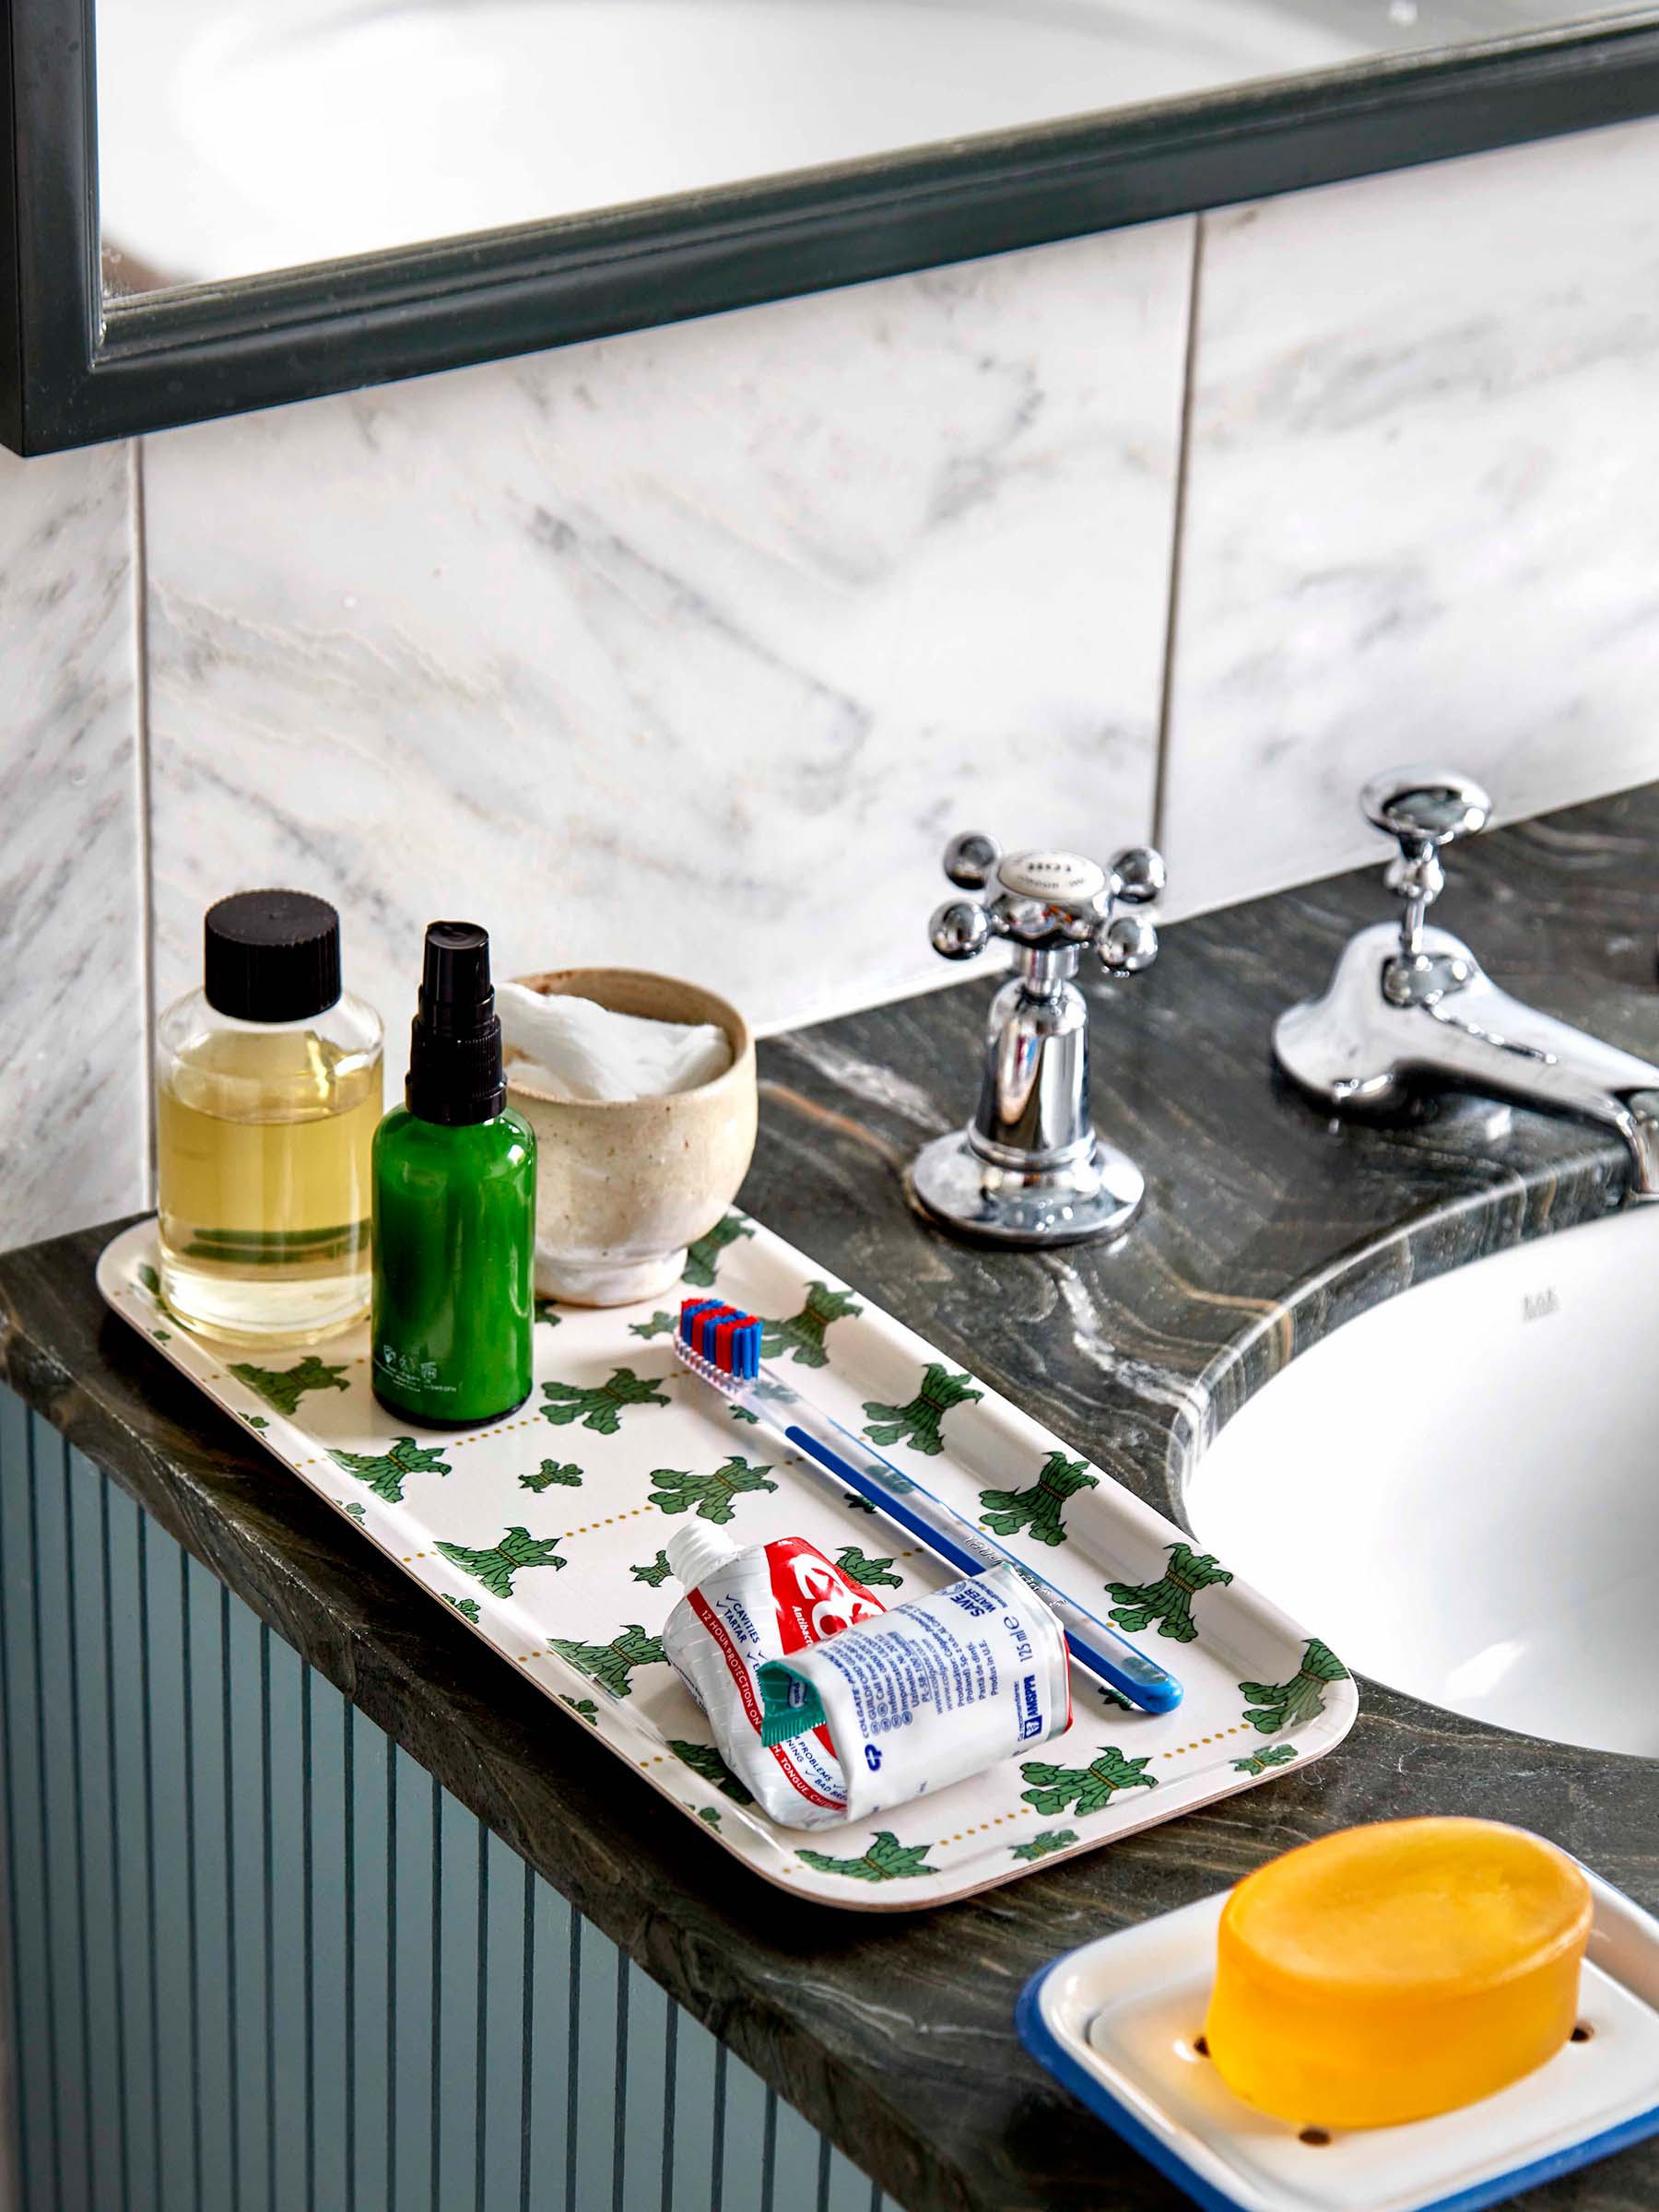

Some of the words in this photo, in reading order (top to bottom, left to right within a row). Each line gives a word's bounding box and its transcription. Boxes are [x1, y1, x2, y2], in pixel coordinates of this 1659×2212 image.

[950, 1594, 985, 1617] SAVE
[964, 1588, 996, 1612] WATER
[724, 1608, 747, 1643] TARTAR
[733, 1603, 760, 1644] CAVITIES
[792, 1606, 814, 1645] Antibact
[1009, 1630, 1028, 1642] ml
[701, 1609, 712, 1621] 12
[710, 1620, 729, 1648] HOUR
[726, 1648, 754, 1708] PROTECTION
[749, 1711, 762, 1725] ON
[1016, 1642, 1033, 1662] 125
[962, 1669, 975, 1704] (Poland)
[975, 1665, 983, 1676] de
[989, 1666, 998, 1696] Produs
[853, 1665, 877, 1721] GUILDFORD
[874, 1682, 884, 1700] Call
[1023, 1675, 1039, 1716] AMSPPR
[799, 1741, 833, 1782] PROBLEMS
[814, 1778, 831, 1793] BAD
